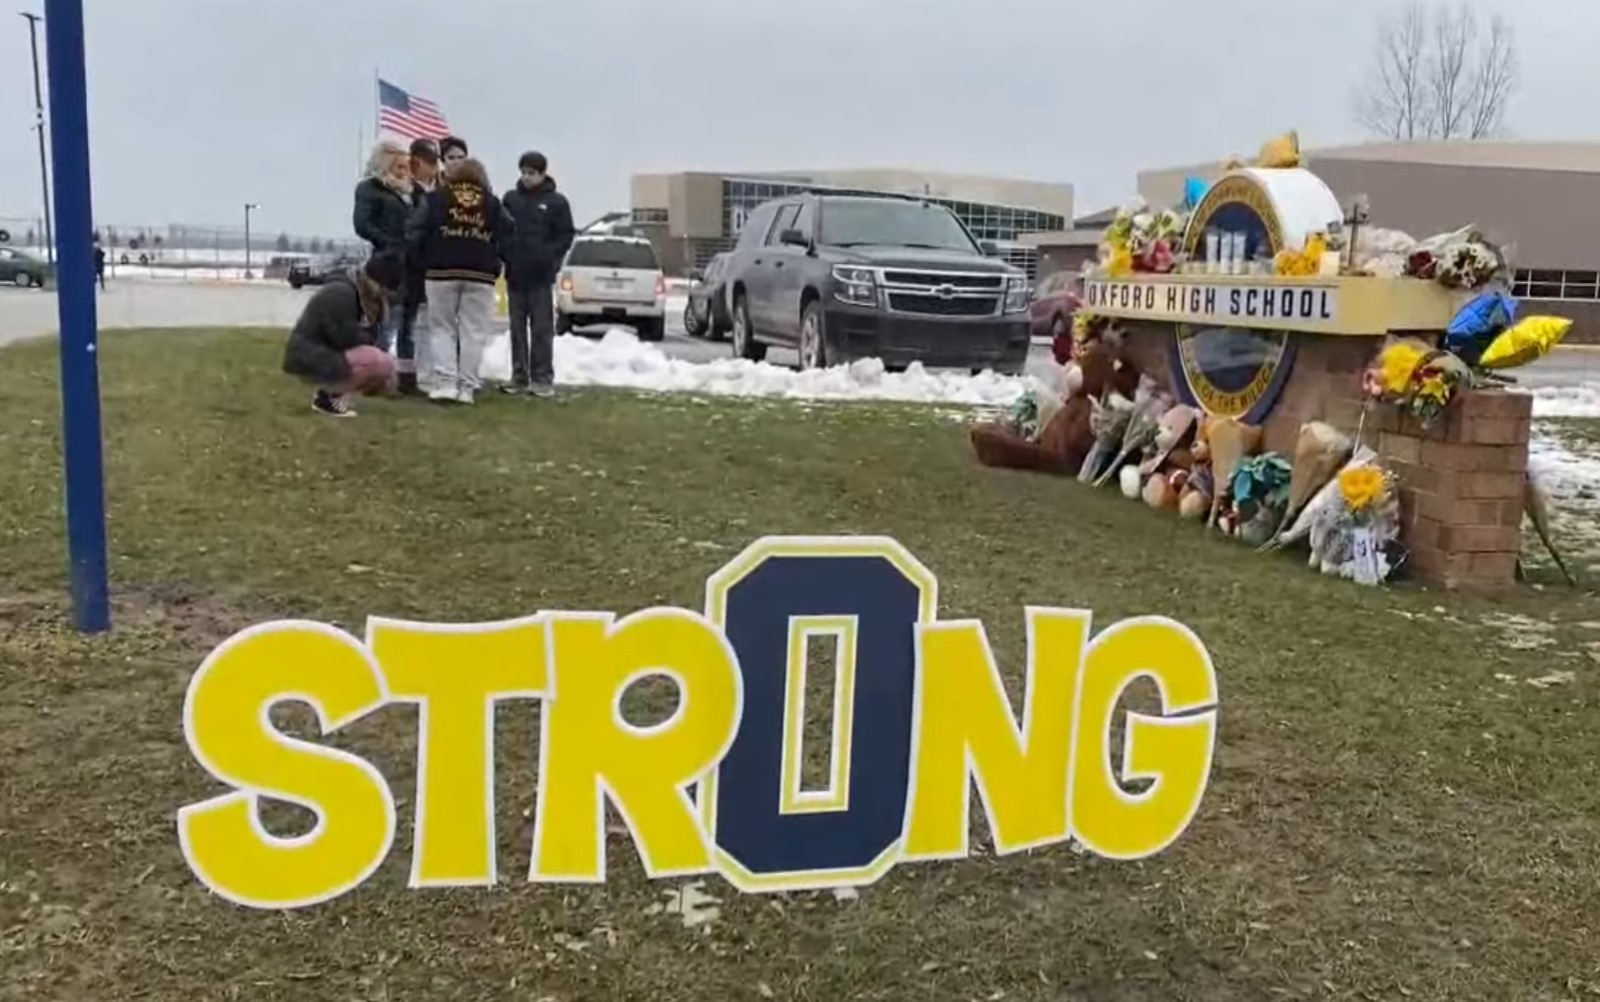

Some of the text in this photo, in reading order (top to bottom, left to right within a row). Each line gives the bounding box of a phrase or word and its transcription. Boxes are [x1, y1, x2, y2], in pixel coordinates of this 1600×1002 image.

[1088, 284, 1331, 319] OXFORD HIGH SCHOOL
[178, 535, 1218, 909] STRONG
